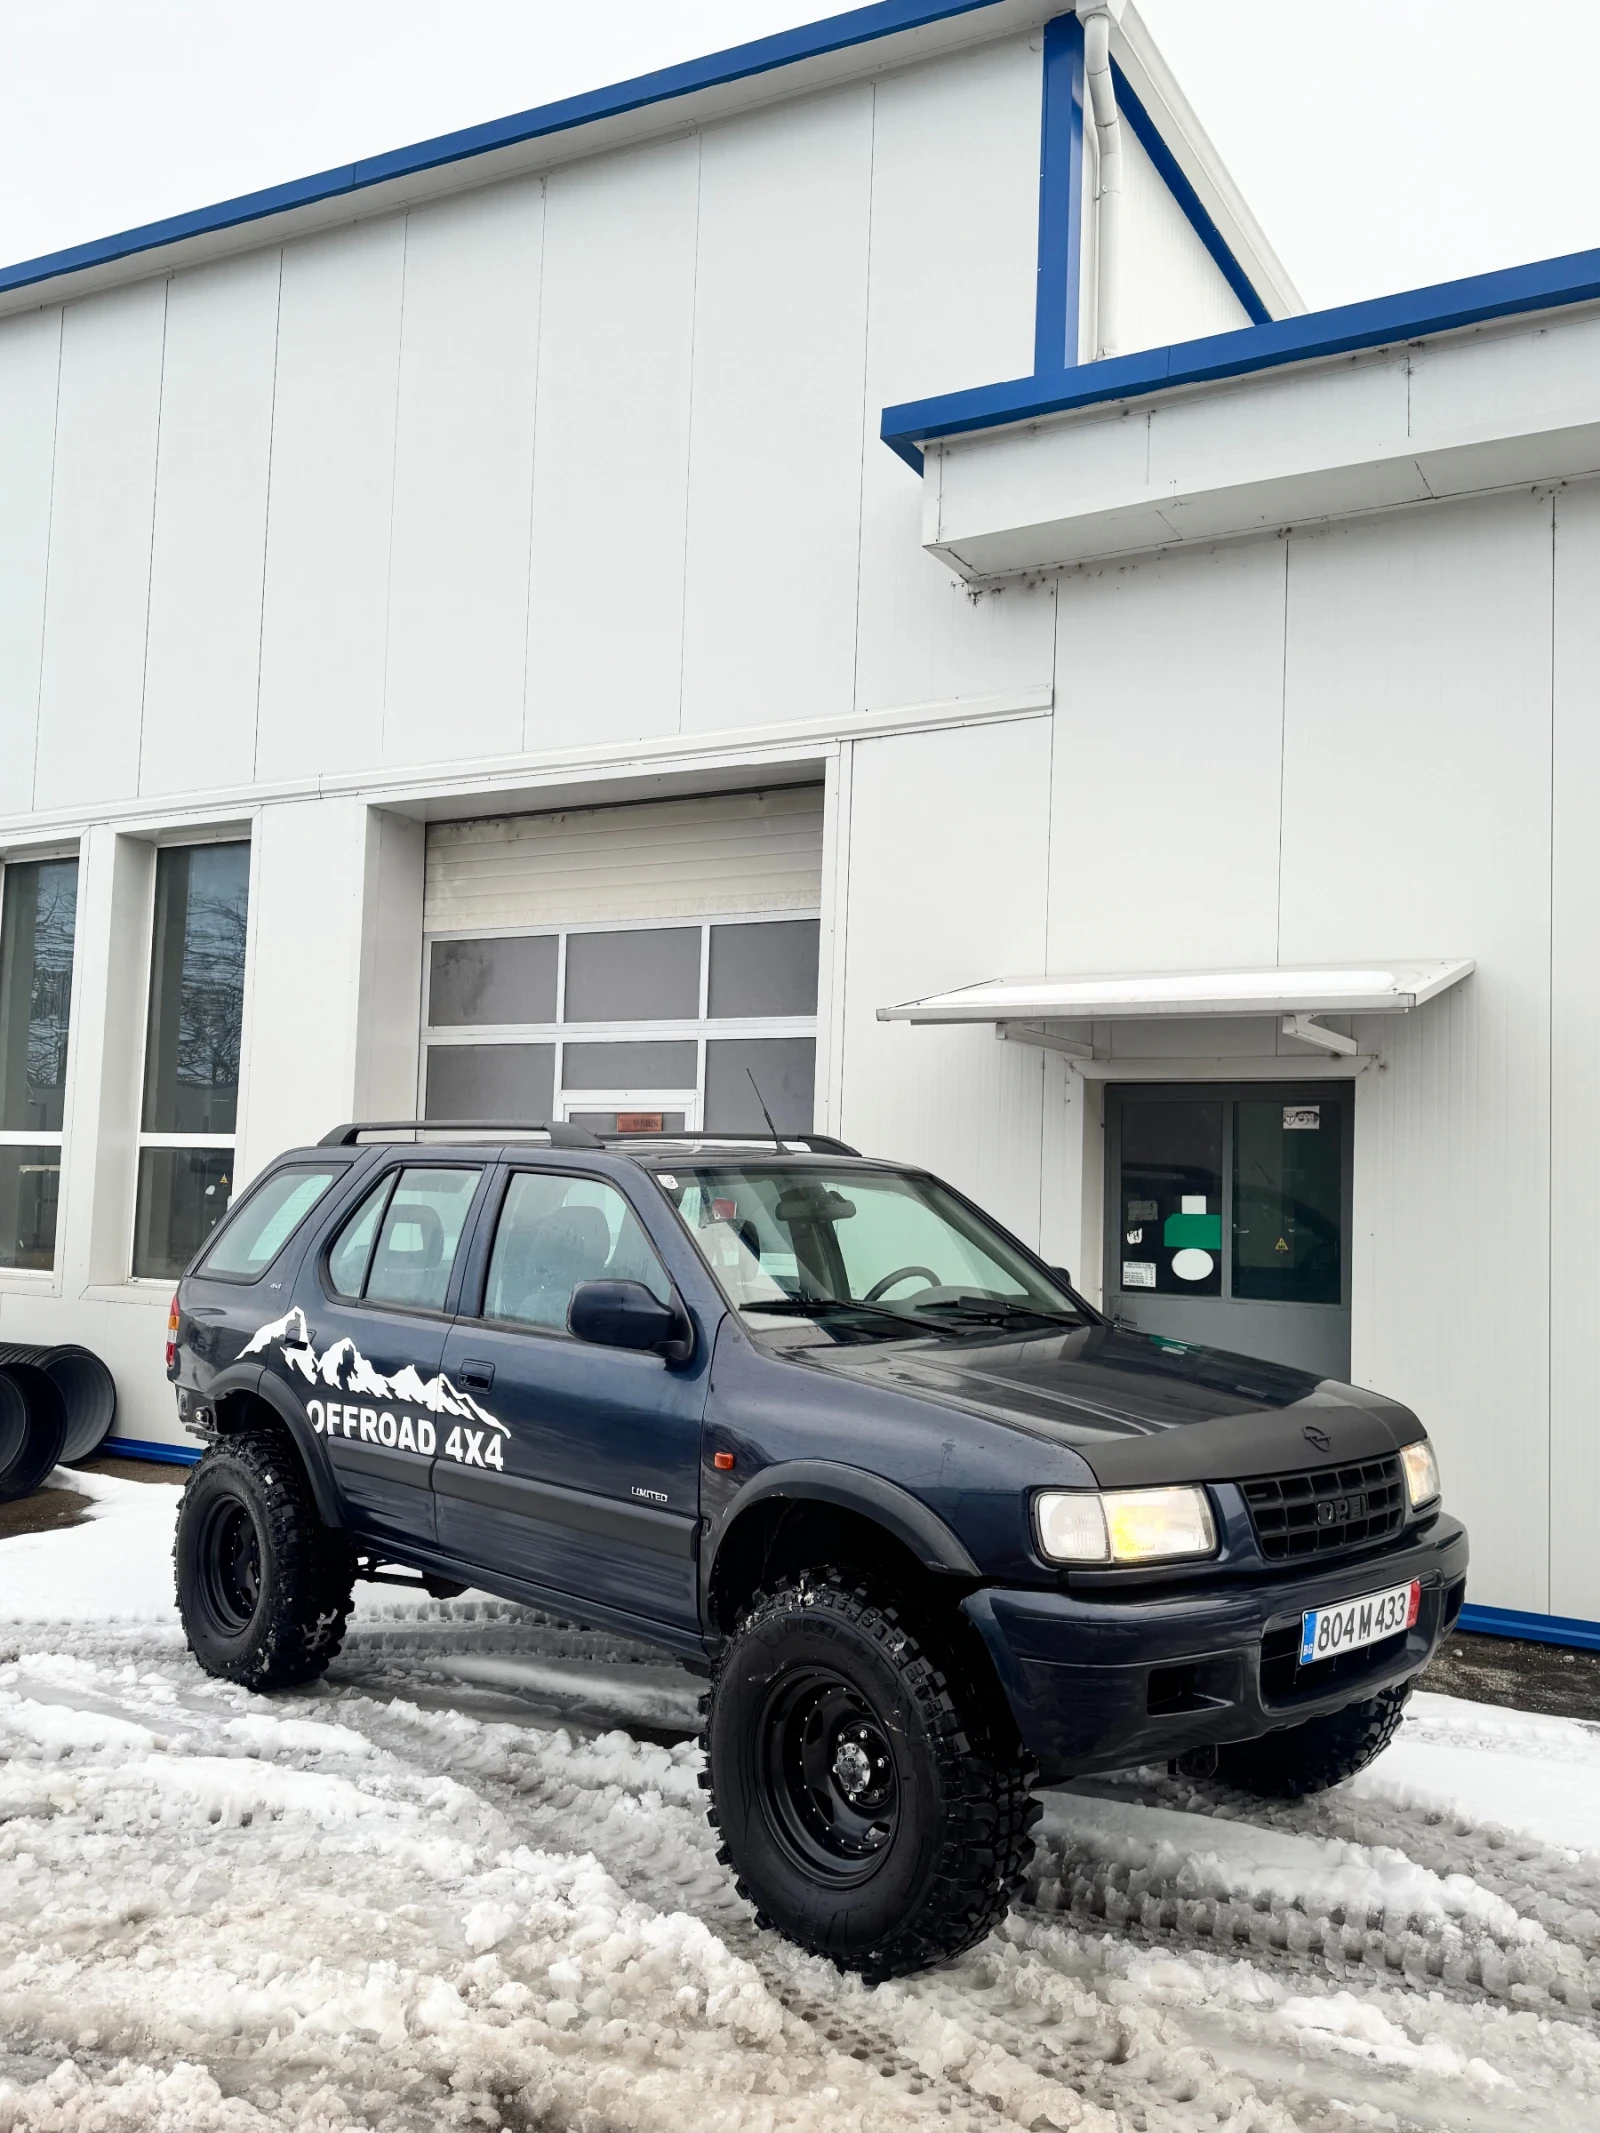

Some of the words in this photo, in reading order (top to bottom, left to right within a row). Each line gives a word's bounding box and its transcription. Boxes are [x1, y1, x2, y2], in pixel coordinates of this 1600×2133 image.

[306, 1399, 437, 1456] OFFROAD
[445, 1426, 504, 1472] 4X4
[631, 1486, 668, 1502] LIMITED
[1317, 1495, 1368, 1525] OPEL
[1303, 1643, 1314, 1656] BG
